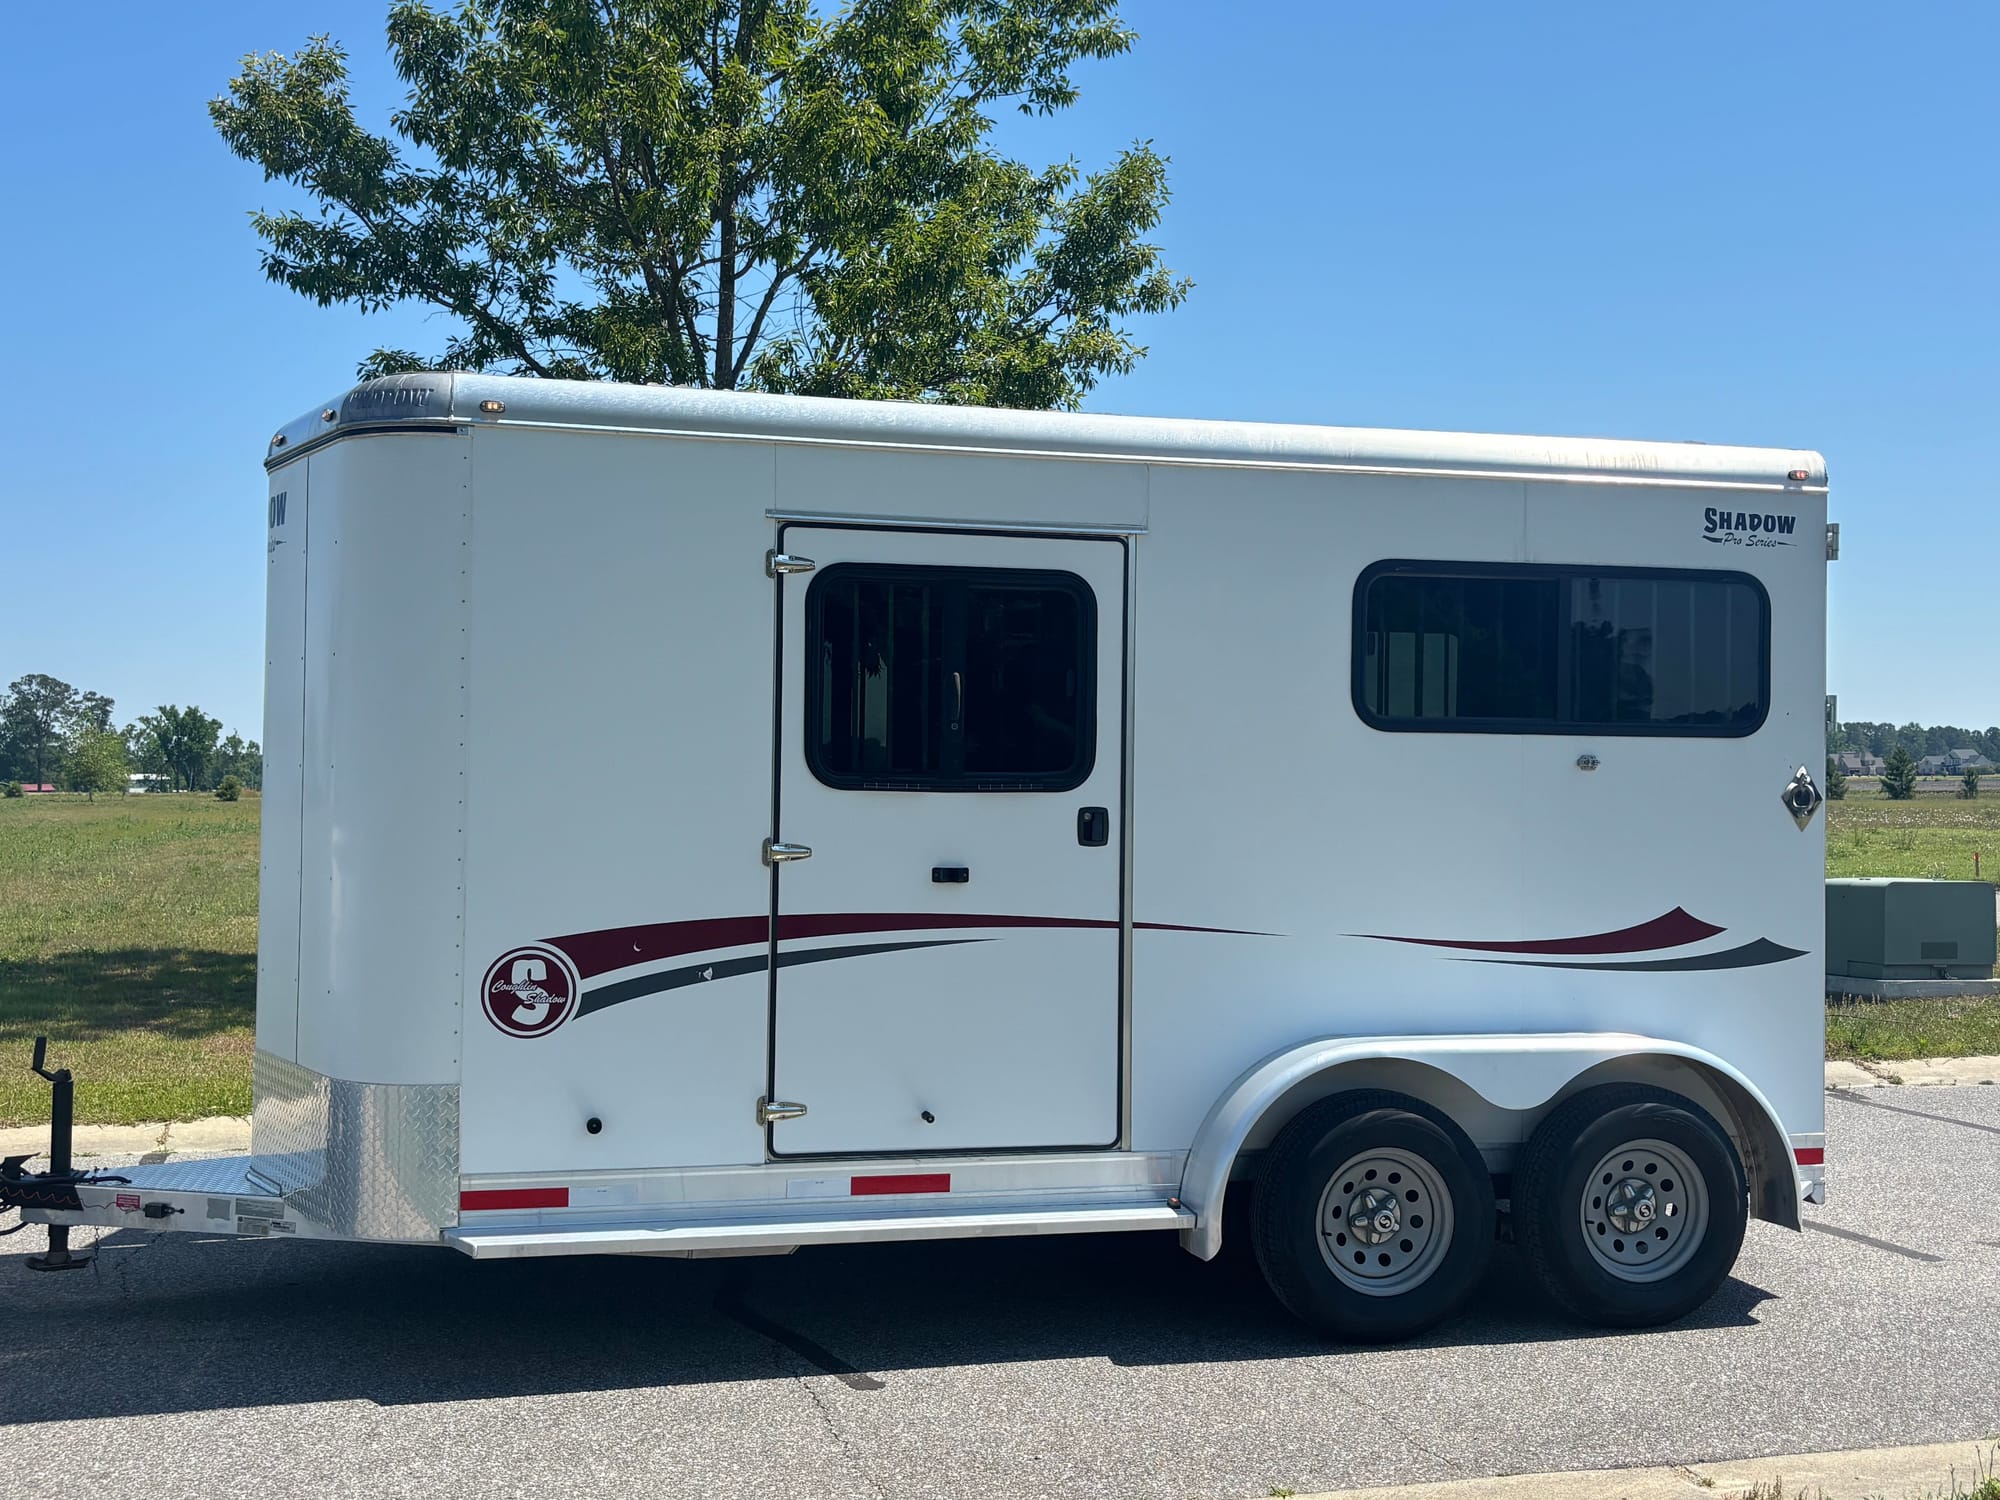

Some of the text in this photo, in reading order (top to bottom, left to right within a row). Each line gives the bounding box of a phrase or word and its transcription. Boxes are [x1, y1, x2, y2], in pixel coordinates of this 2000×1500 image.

[1704, 507, 1796, 534] SHADOW
[1723, 532, 1777, 548] Pro Series
[491, 979, 538, 994] Coughlin
[524, 991, 566, 1004] Shadow
